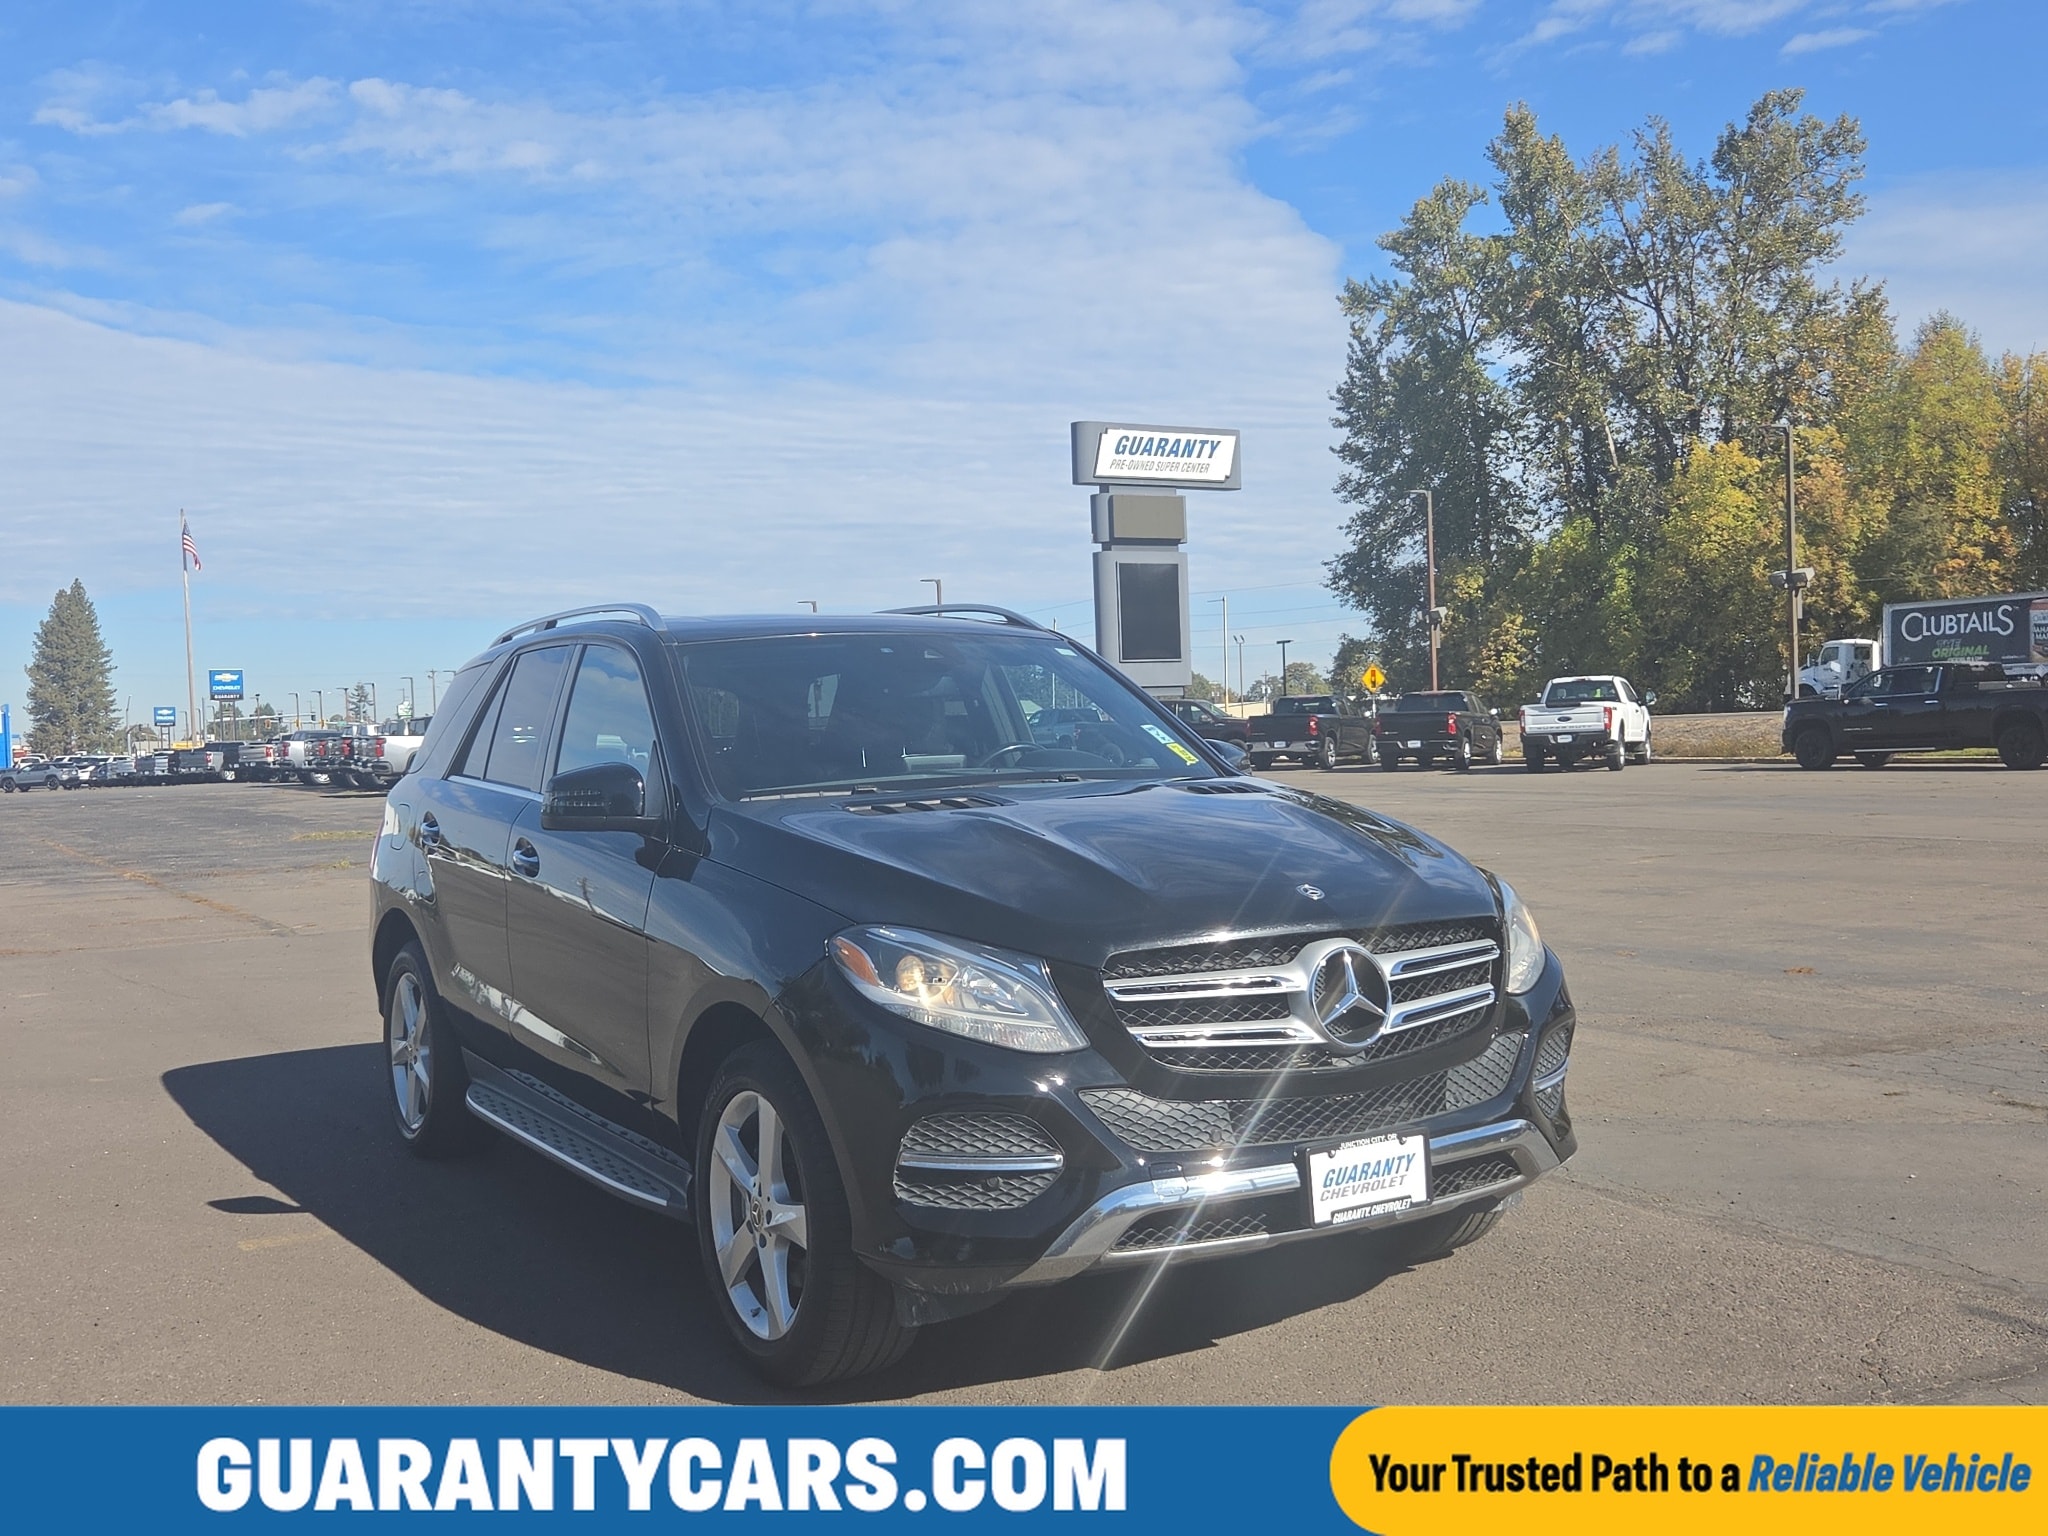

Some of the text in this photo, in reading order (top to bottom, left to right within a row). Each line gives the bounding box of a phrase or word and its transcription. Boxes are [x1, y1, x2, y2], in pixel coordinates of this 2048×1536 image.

[1114, 435, 1222, 459] GUARANTY
[1109, 458, 1210, 474] PRE-OWNED SUPER CENTER
[1901, 604, 2014, 642] CLUBTAILS
[1931, 645, 1990, 658] ORIGINAL
[1339, 1137, 1370, 1150] JUNCTION
[1322, 1152, 1416, 1189] GUARANTY
[1320, 1174, 1408, 1202] CHEVROLET
[1371, 1198, 1412, 1216] CHEVROLET
